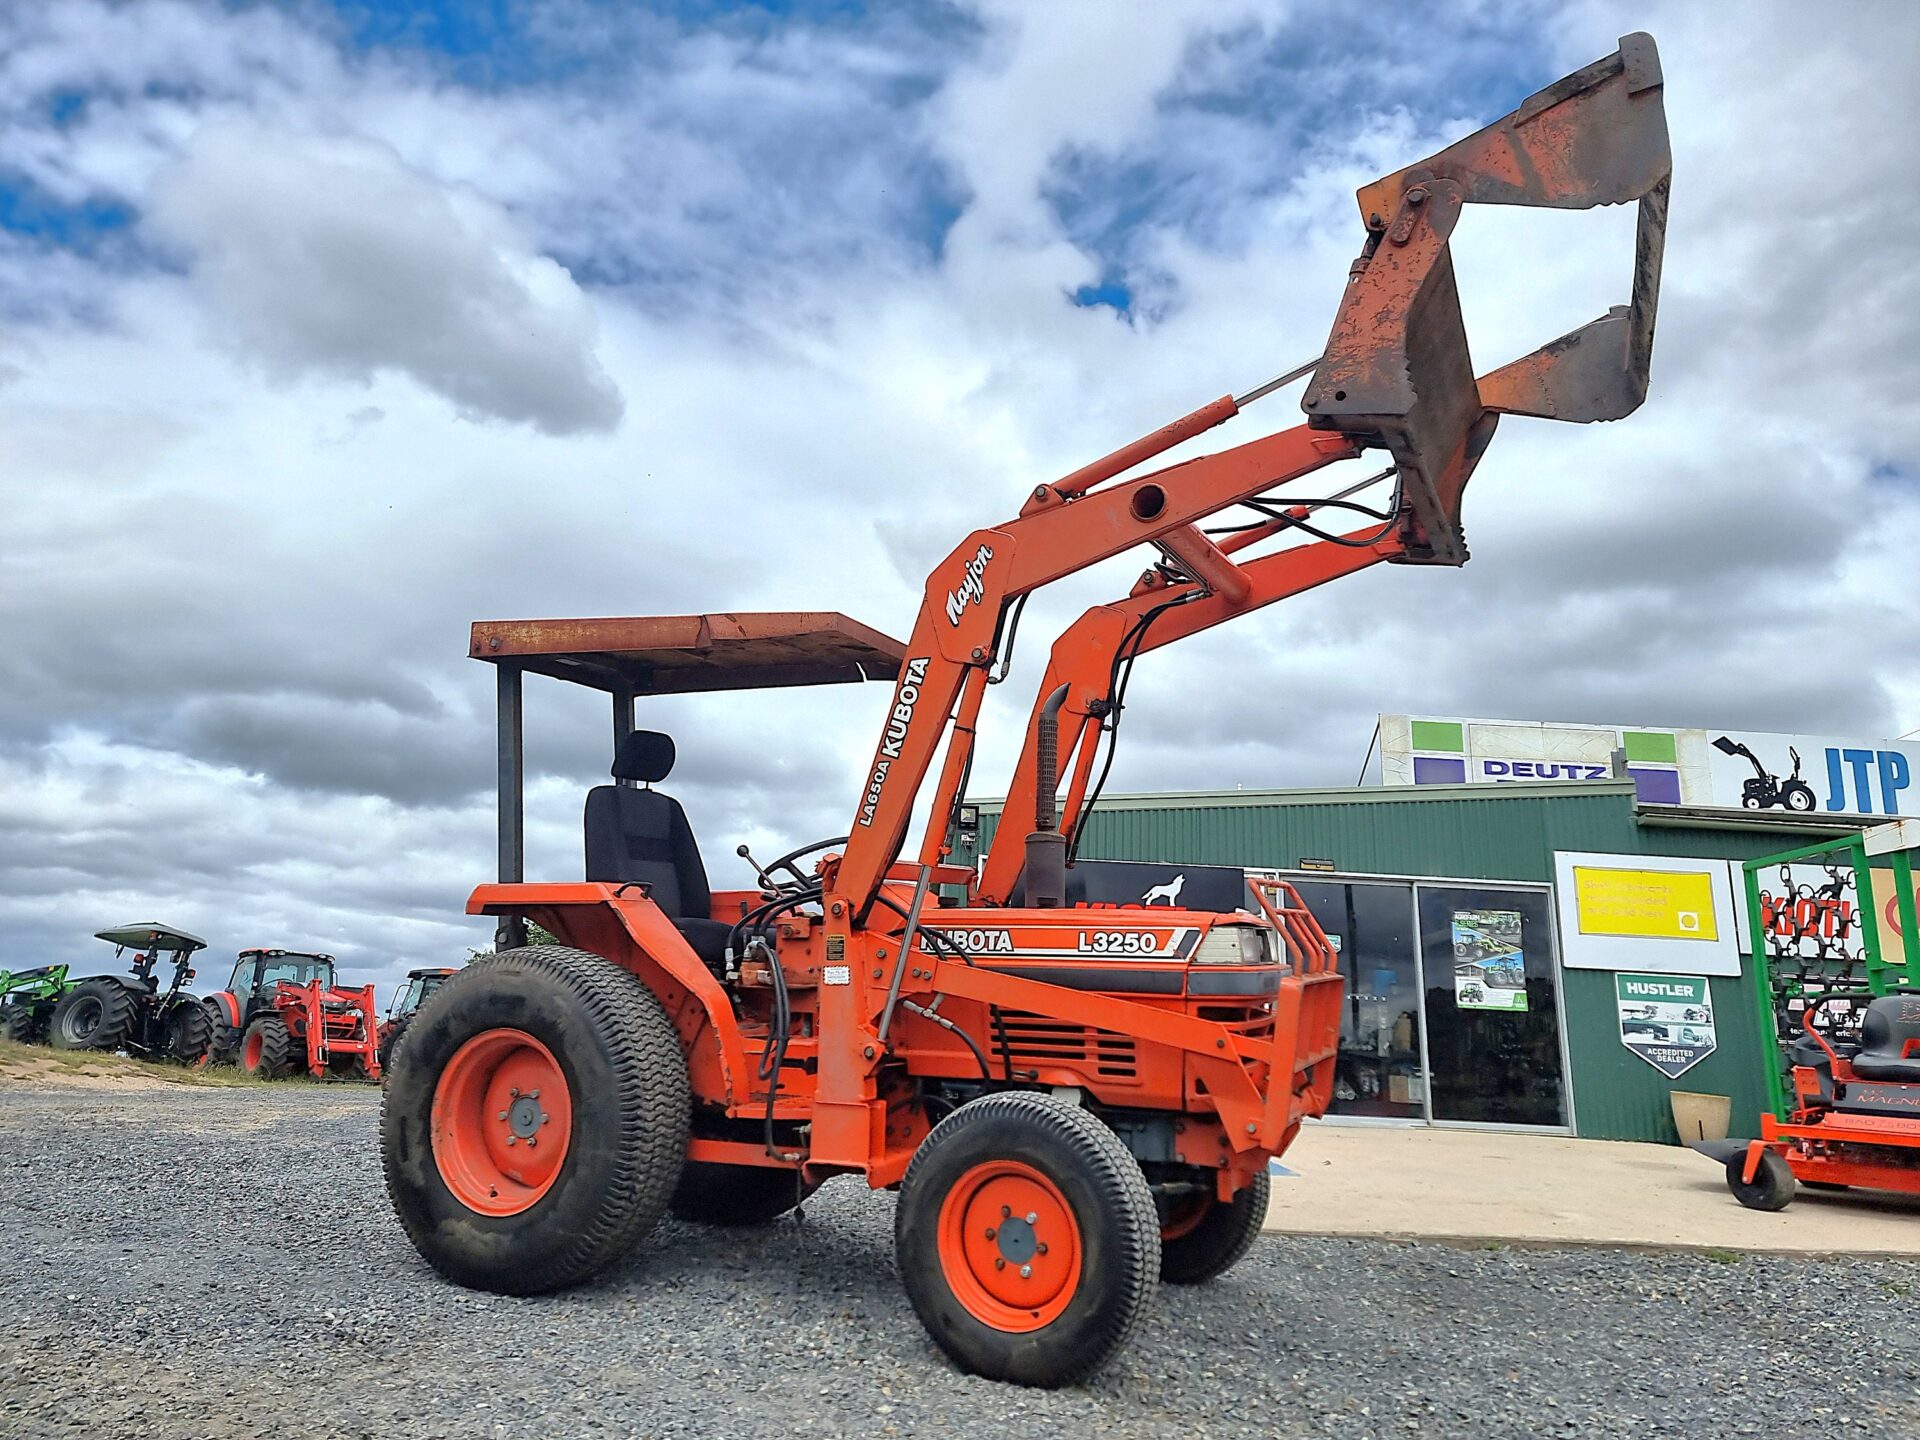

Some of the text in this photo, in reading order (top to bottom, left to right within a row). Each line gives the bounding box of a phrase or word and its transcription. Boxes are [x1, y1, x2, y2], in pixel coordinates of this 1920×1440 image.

[859, 657, 931, 827] LA650A KUBOTA
[1483, 760, 1608, 780] DEUTZ
[1825, 747, 1911, 815] JTP
[1761, 896, 1850, 939] KIOTI
[920, 930, 1157, 953] KUBOTA L3250
[1626, 982, 1695, 997] HUSTLER
[1647, 1048, 1694, 1057] ACCREDITED
